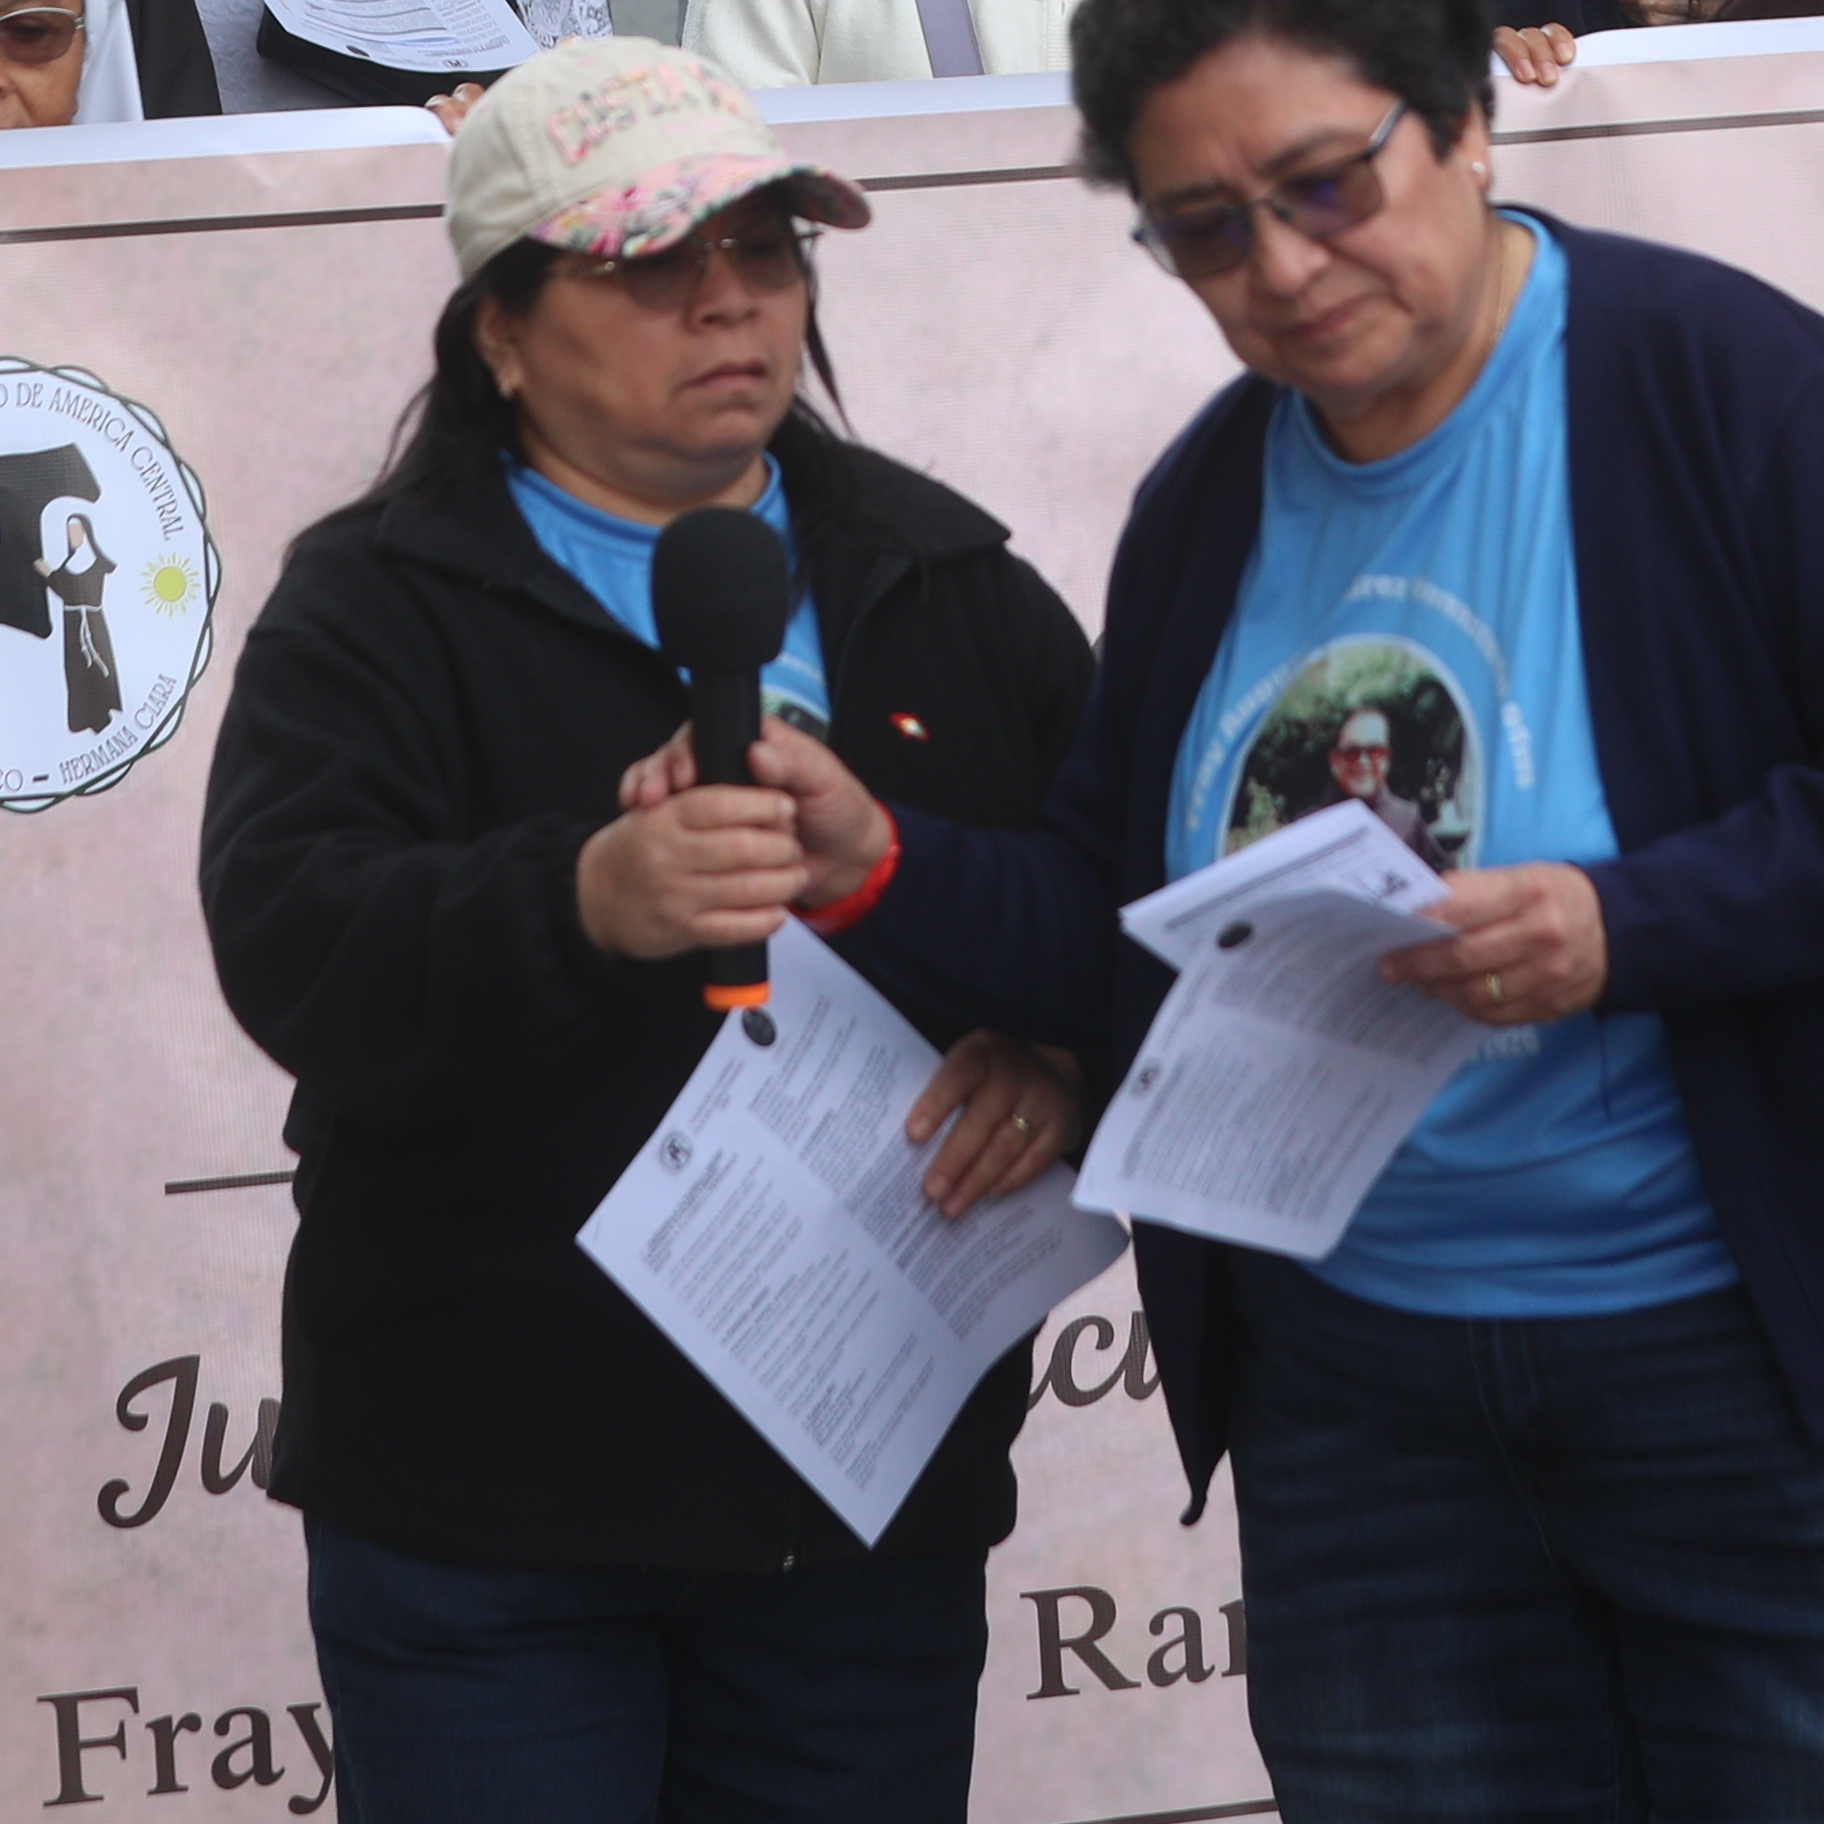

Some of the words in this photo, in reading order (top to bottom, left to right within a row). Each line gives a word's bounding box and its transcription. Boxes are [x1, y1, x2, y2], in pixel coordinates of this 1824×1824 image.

[16, 381, 43, 409] DE
[49, 387, 135, 453] AMERICA
[130, 446, 185, 542] CENTRAL
[59, 724, 139, 786] HERMANA
[136, 672, 178, 731] CLARA
[36, 1685, 335, 1816] Fray
